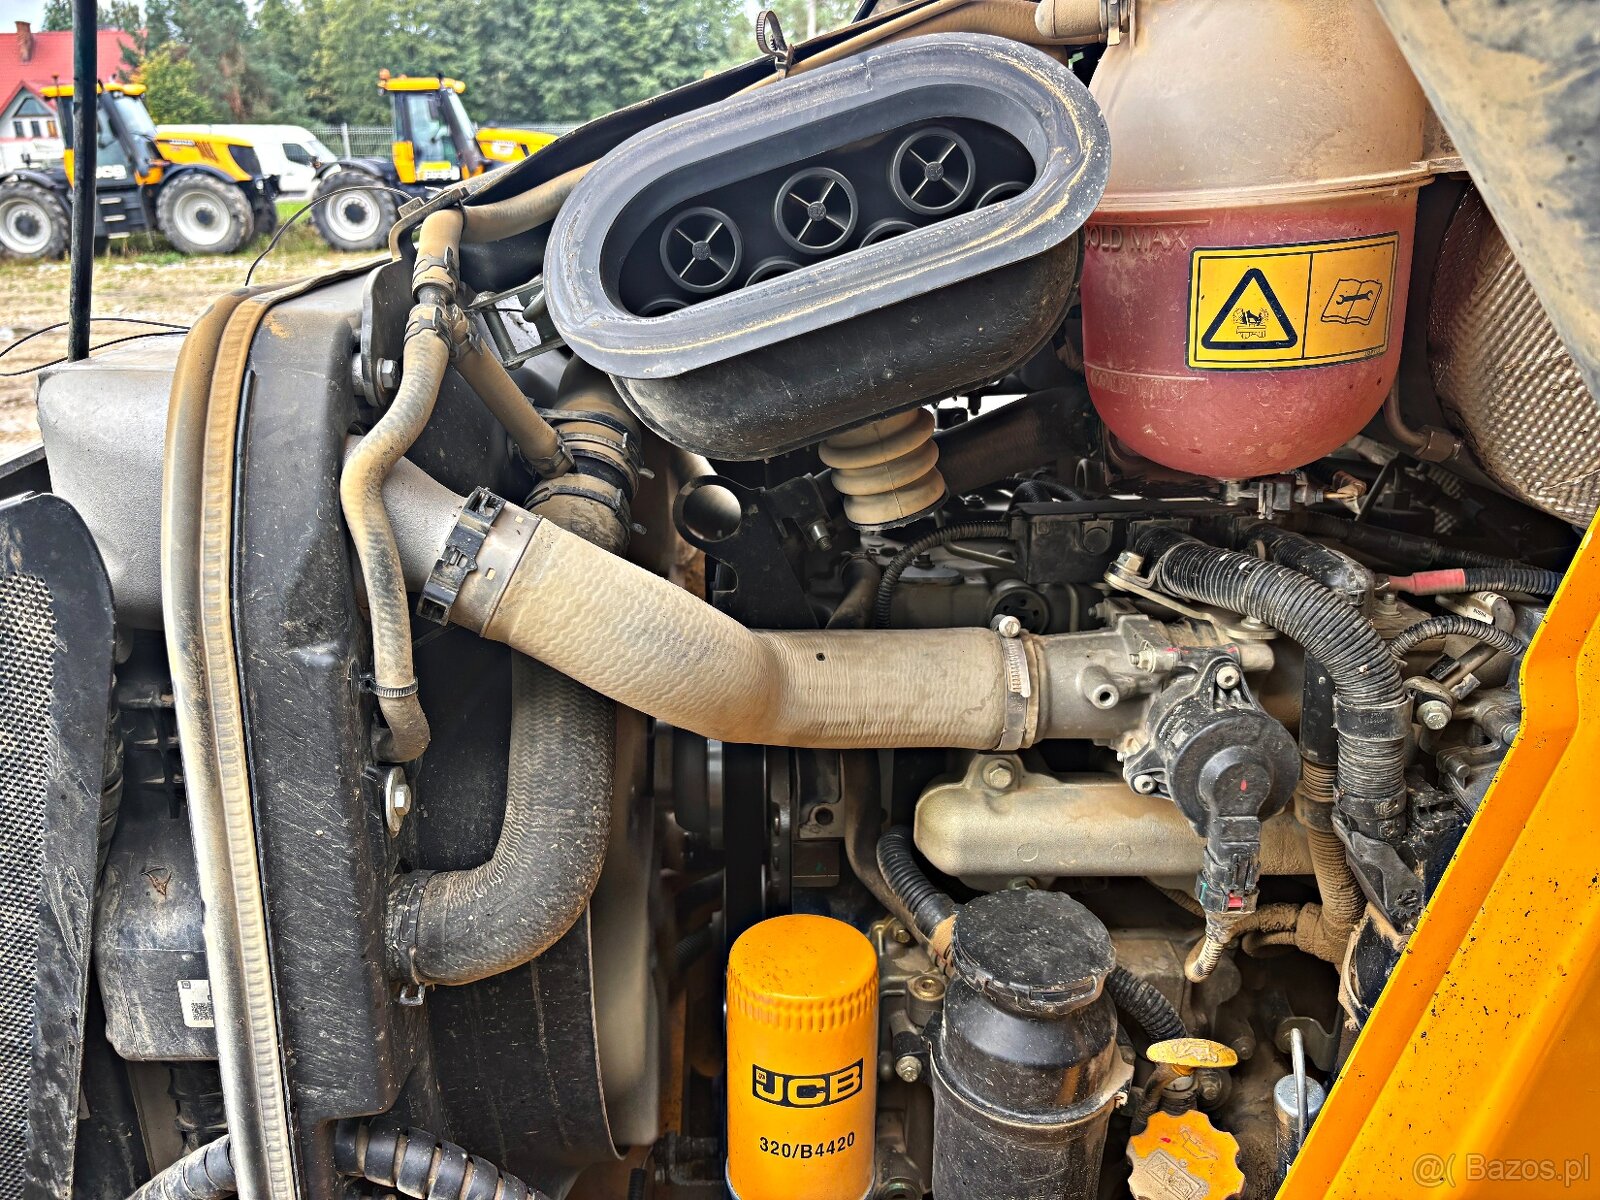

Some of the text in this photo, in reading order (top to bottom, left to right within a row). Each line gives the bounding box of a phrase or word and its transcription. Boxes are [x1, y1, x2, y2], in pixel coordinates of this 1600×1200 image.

[1130, 225, 1188, 251] MAX
[755, 1065, 861, 1105] JCB
[759, 1131, 855, 1159] 320/B4420
